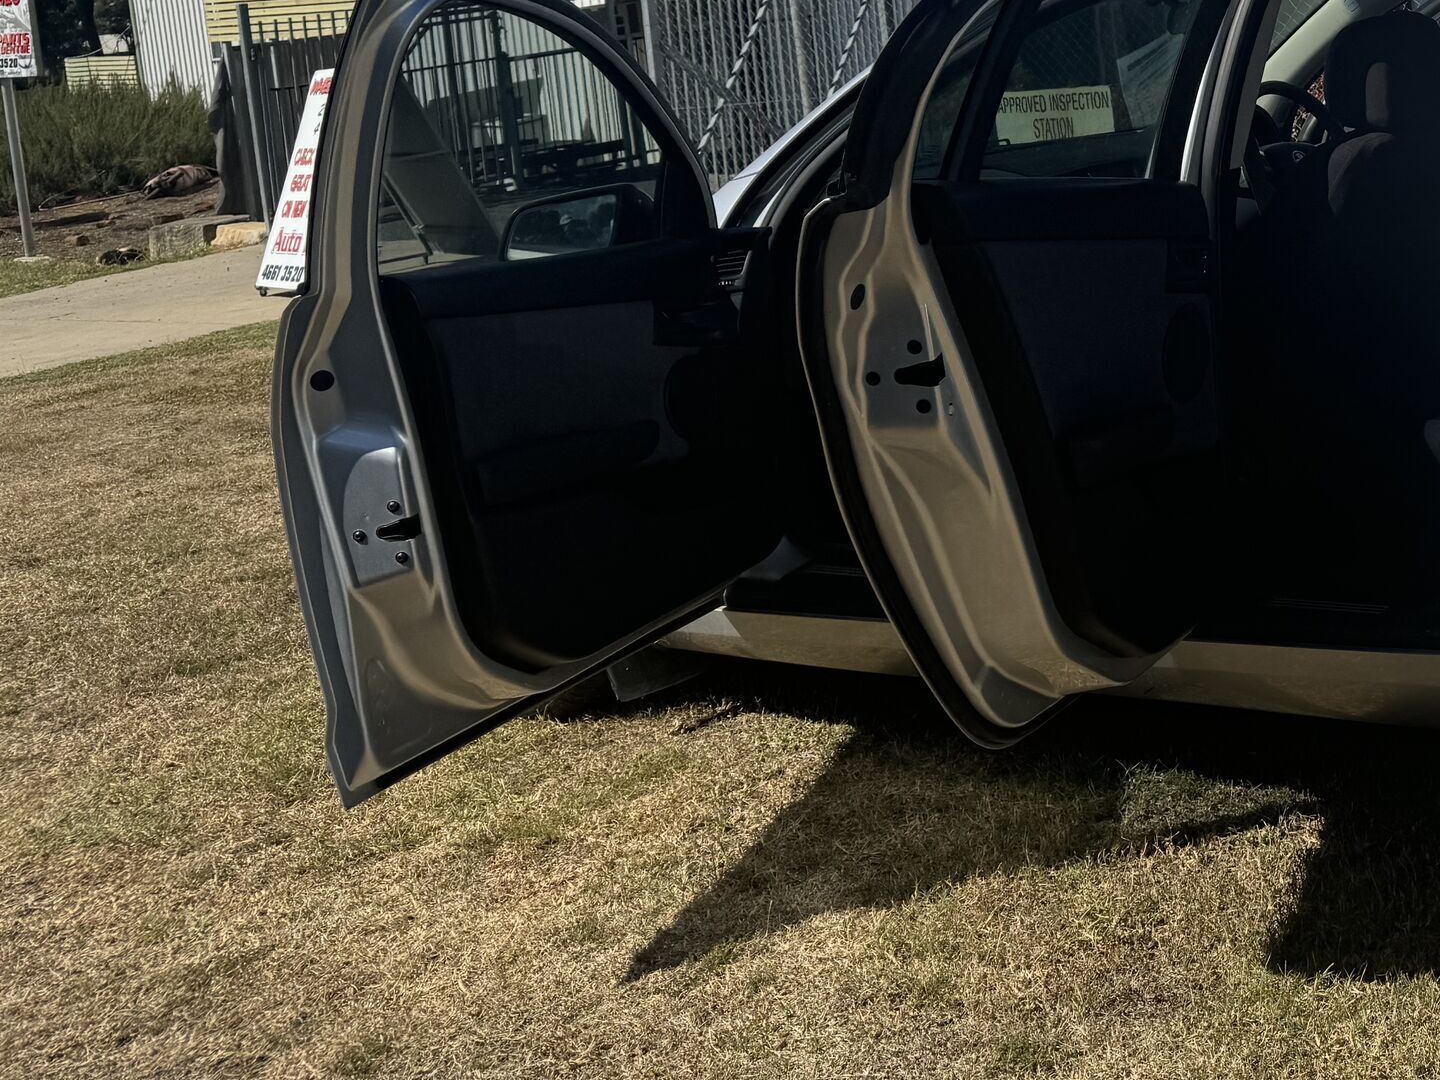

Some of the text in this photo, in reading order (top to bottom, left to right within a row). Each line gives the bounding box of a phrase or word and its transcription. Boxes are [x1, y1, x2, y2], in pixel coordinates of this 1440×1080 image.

[1049, 91, 1110, 112] INSPECTION
[1032, 117, 1074, 140] STATION
[273, 227, 304, 253] Auto
[261, 264, 304, 282] 4661 3520
